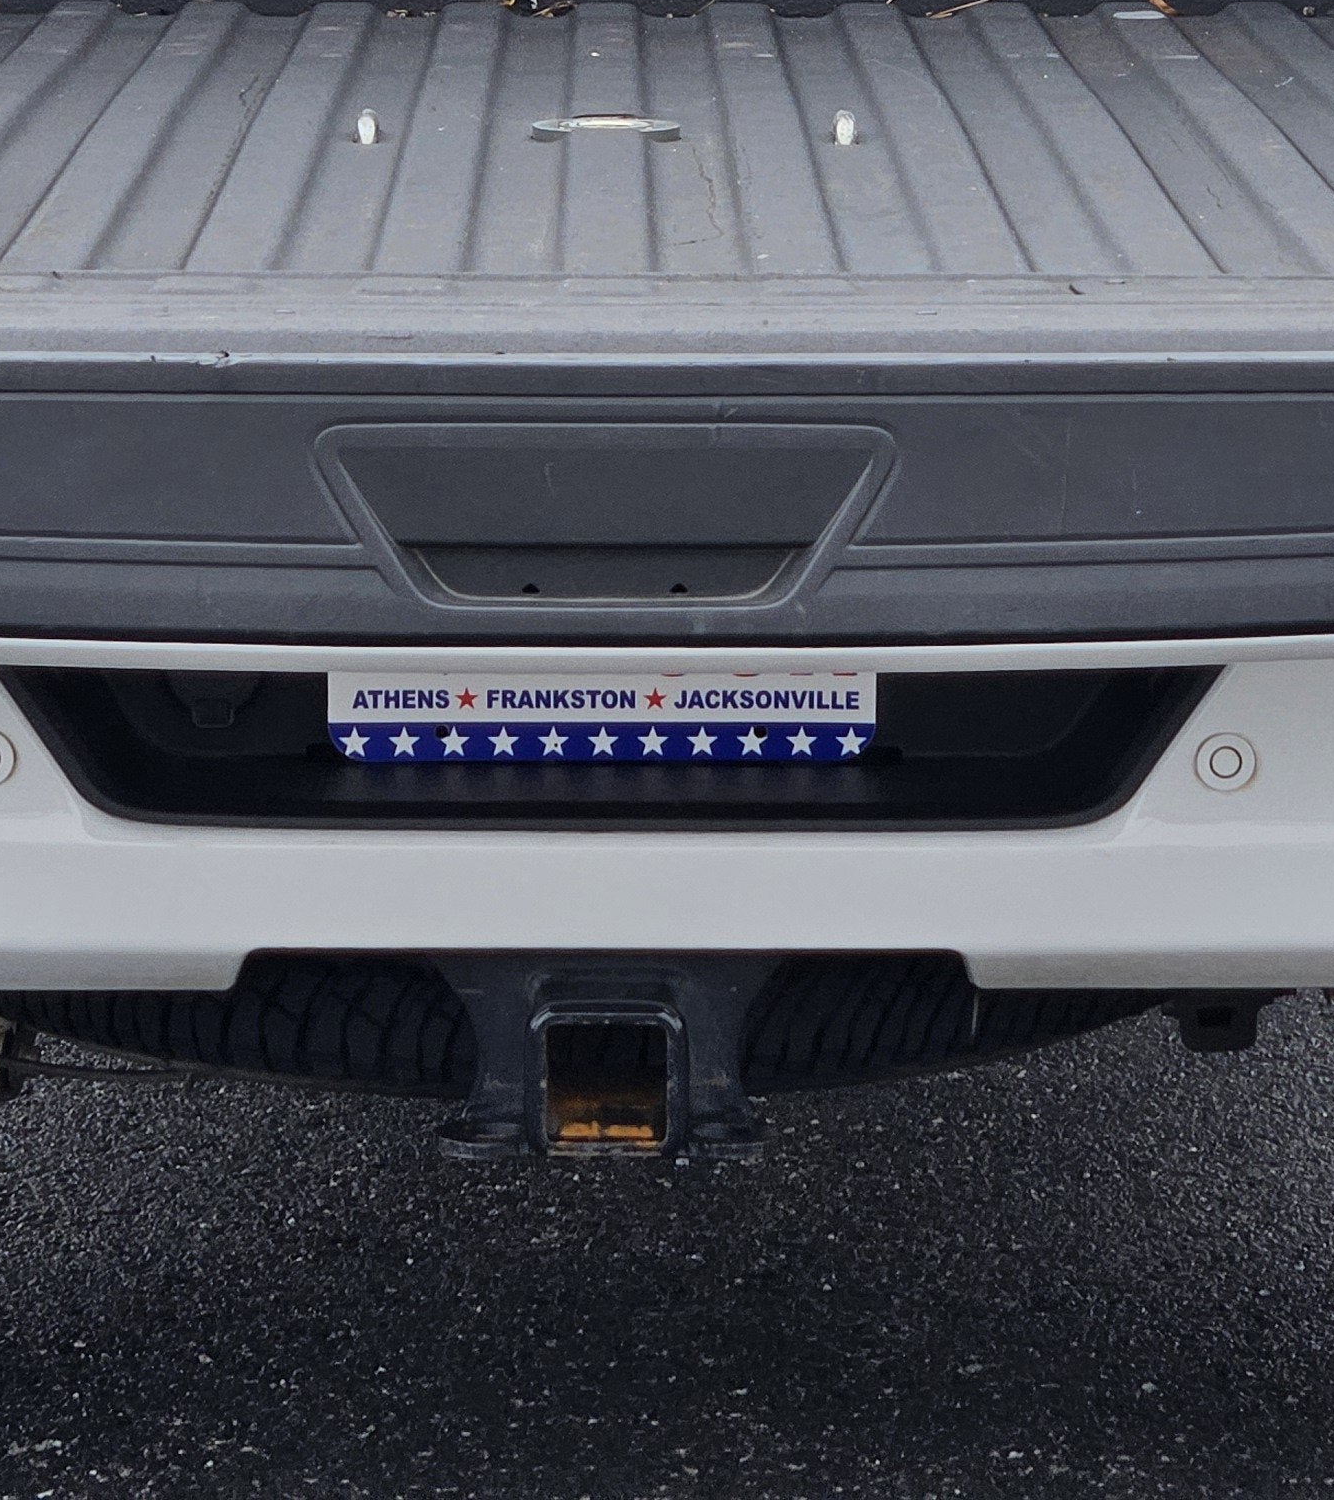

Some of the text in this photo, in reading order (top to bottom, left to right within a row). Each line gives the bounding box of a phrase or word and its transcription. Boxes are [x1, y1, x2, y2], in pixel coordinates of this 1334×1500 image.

[352, 689, 860, 710] ATHENS FRANKSTON JACKSONVILLE
